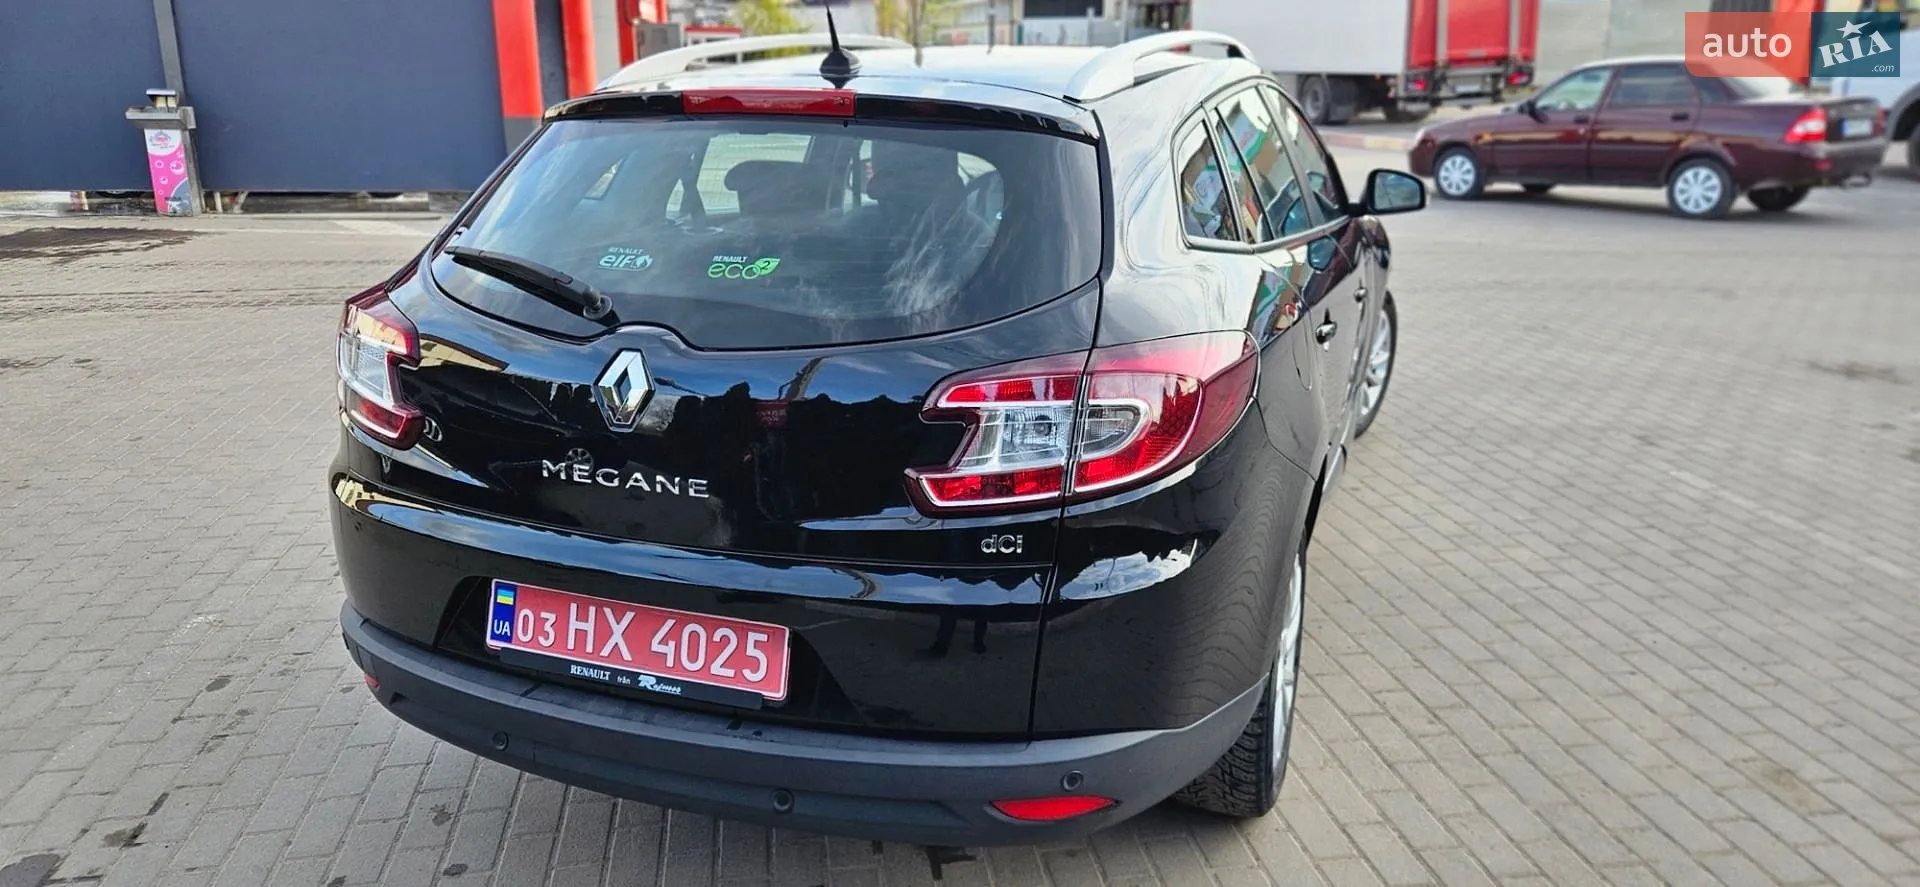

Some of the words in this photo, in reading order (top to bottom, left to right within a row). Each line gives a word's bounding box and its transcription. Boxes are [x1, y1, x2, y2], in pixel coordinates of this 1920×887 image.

[712, 255, 748, 263] RENAULT
[541, 459, 710, 498] MEGANE
[980, 534, 1023, 554] dCi
[493, 619, 511, 637] UA
[516, 608, 557, 648] 03
[566, 602, 636, 662] HX
[650, 618, 769, 683] 4025
[570, 664, 611, 681] RENAULT
